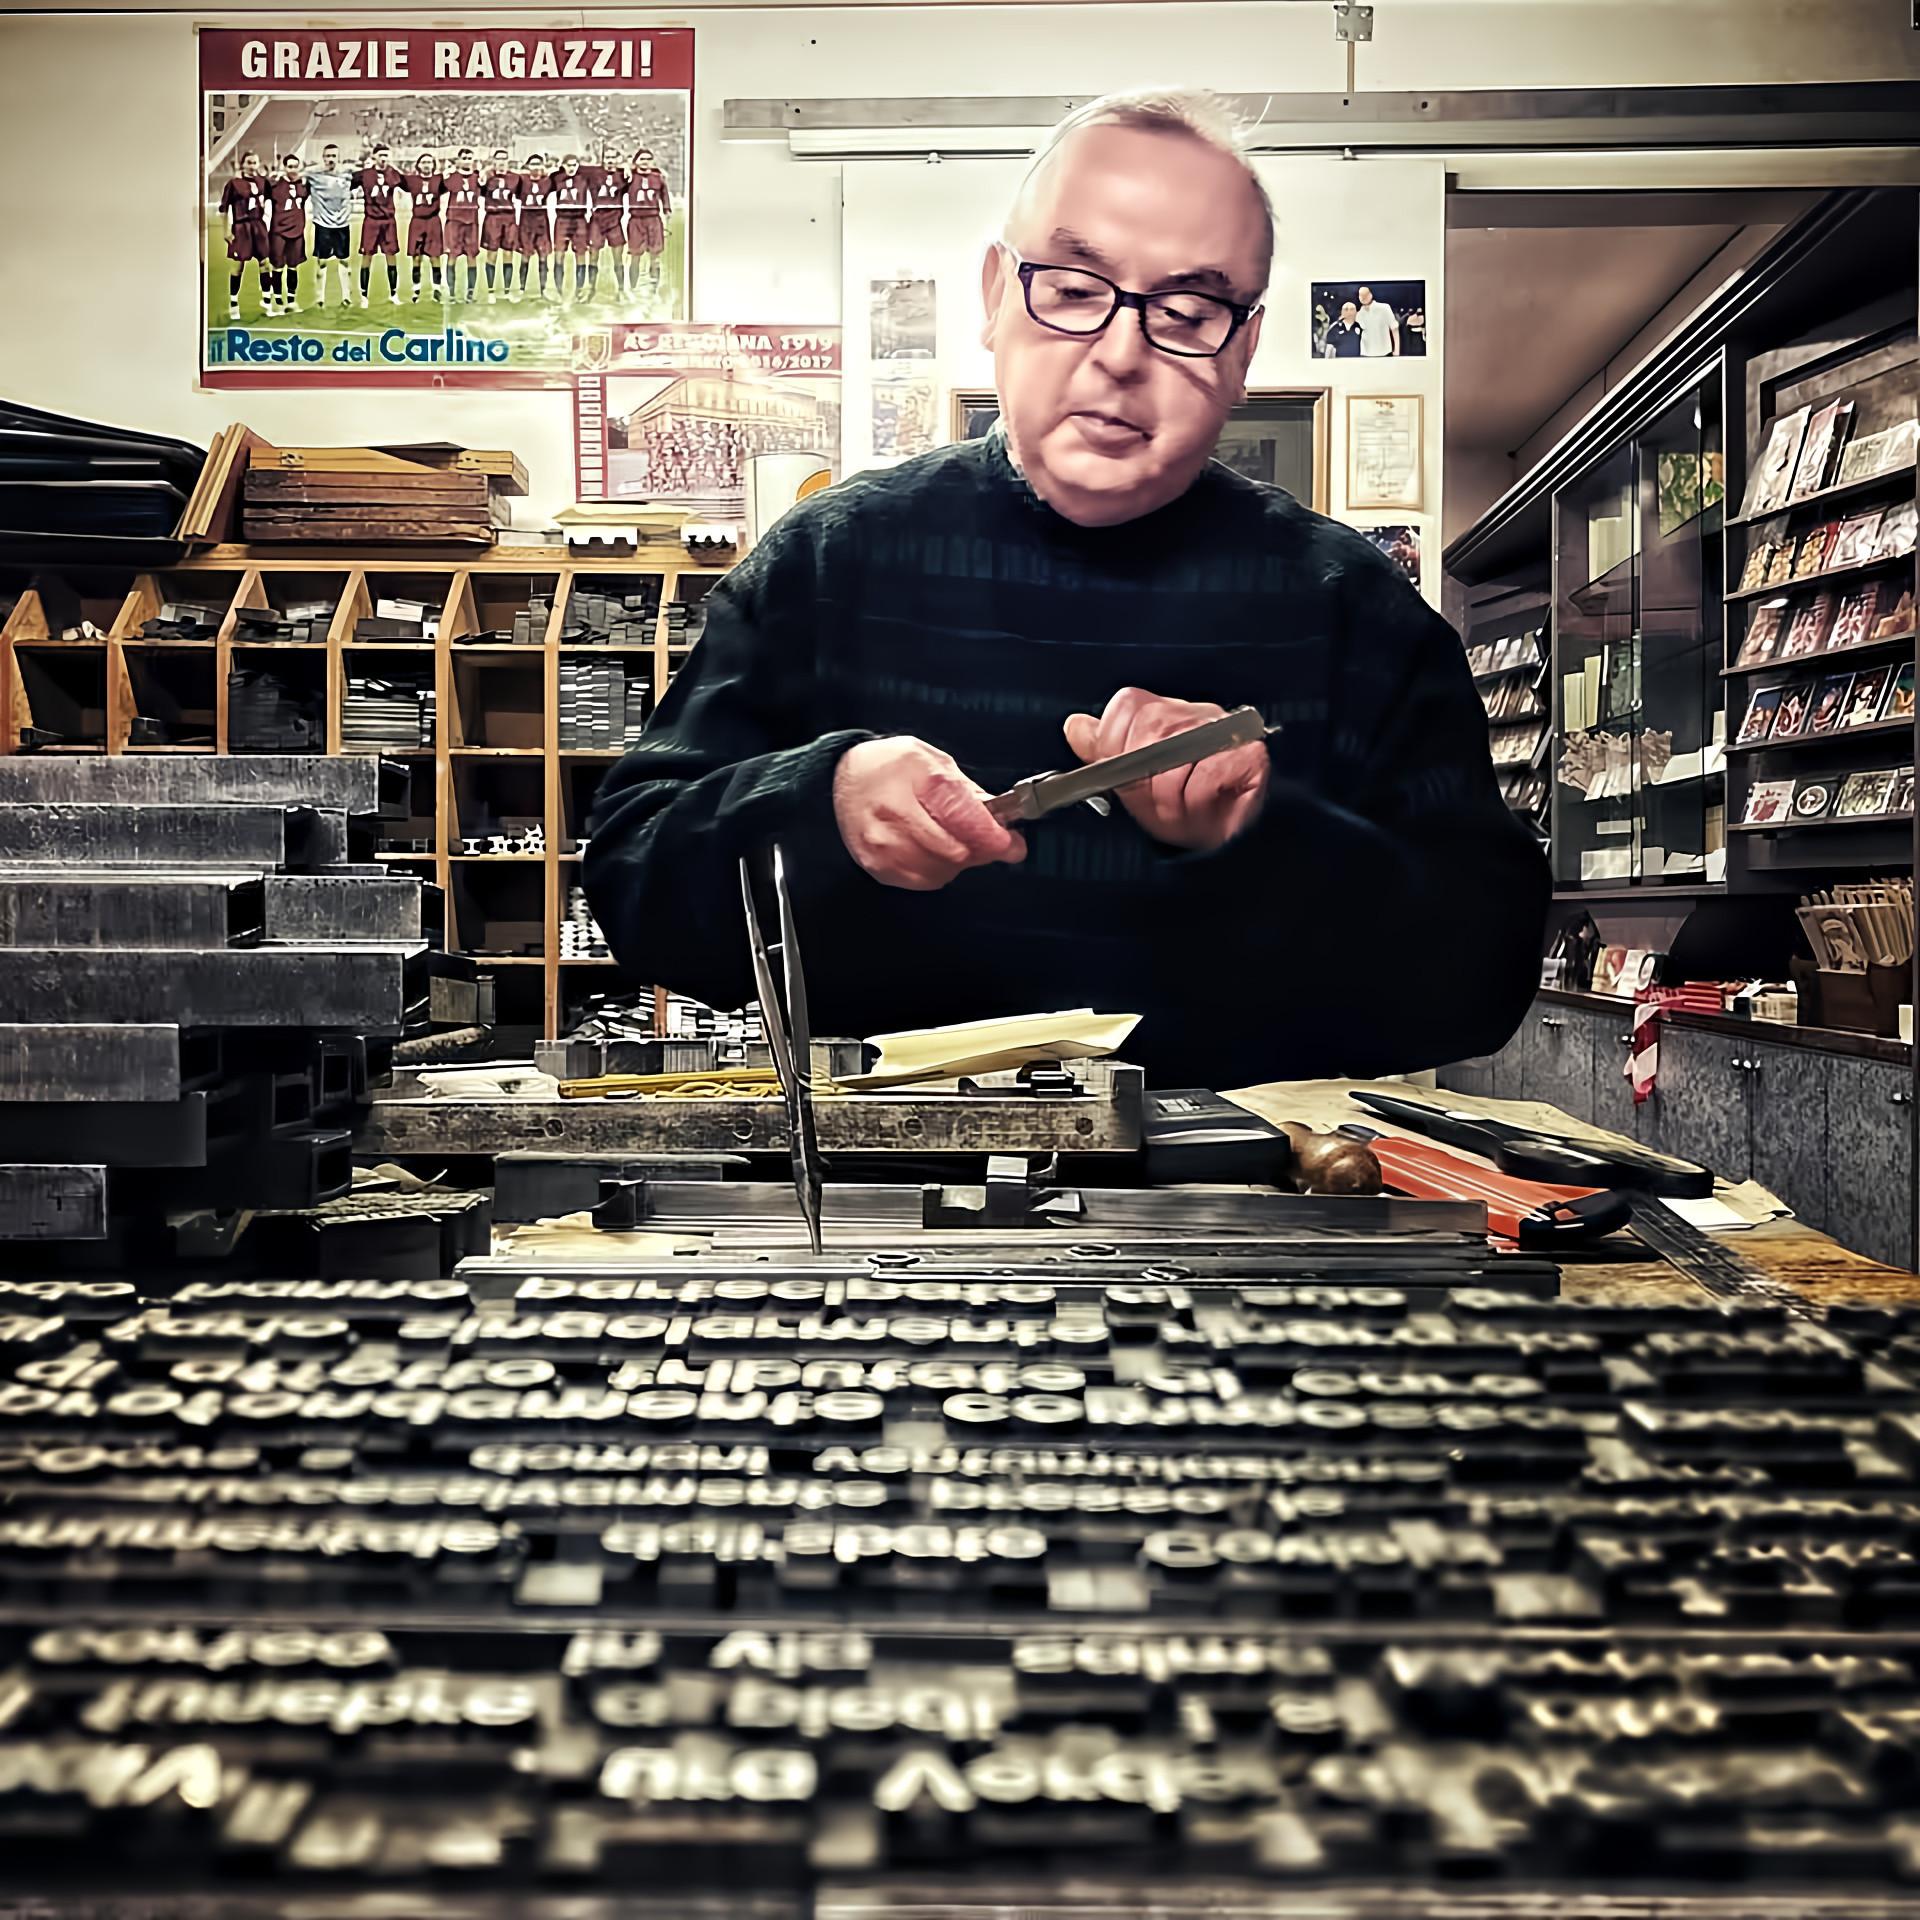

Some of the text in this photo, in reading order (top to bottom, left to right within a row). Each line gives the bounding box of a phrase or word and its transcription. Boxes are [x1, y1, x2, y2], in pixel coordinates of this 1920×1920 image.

[240, 39, 654, 79] GRAZIE RAGAZZI!
[226, 328, 325, 363] Resto
[332, 338, 371, 363] del
[379, 328, 510, 363] Carlino
